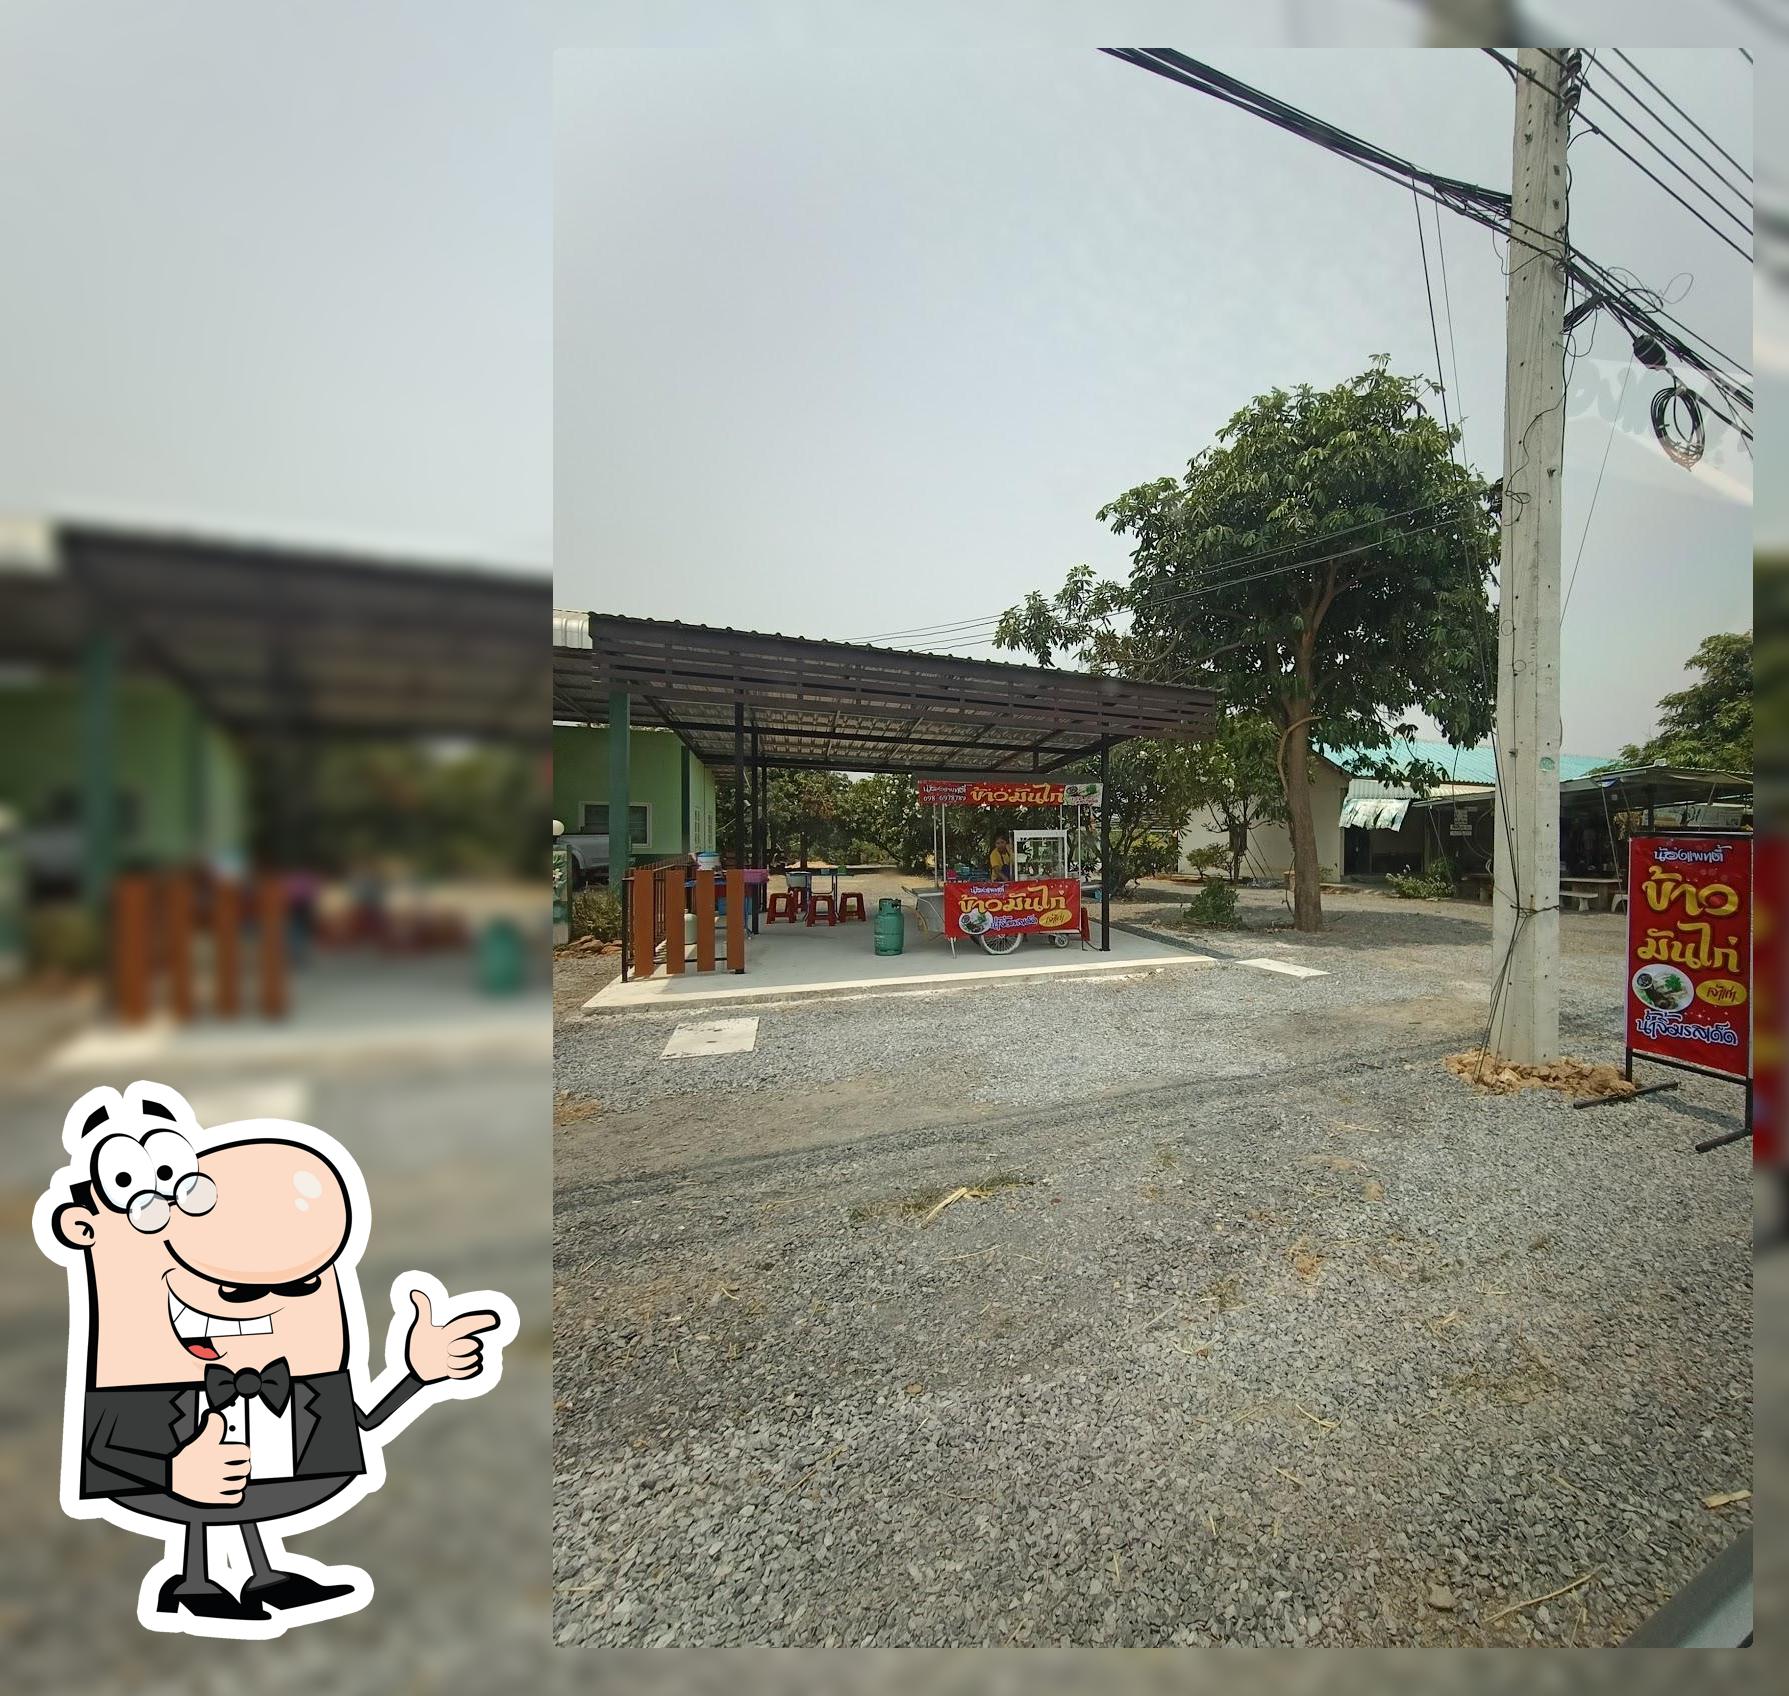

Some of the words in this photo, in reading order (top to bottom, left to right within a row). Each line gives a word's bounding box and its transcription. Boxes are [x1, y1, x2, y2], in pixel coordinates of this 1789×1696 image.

[970, 783, 1065, 804] ข้าวมันไก่
[958, 885, 1067, 912] ข้าวมันไก่
[1642, 865, 1739, 916] ข้าว
[1637, 921, 1740, 973] มันไก่
[1636, 1009, 1738, 1046] น้ำจิ้มรสเด็ด
